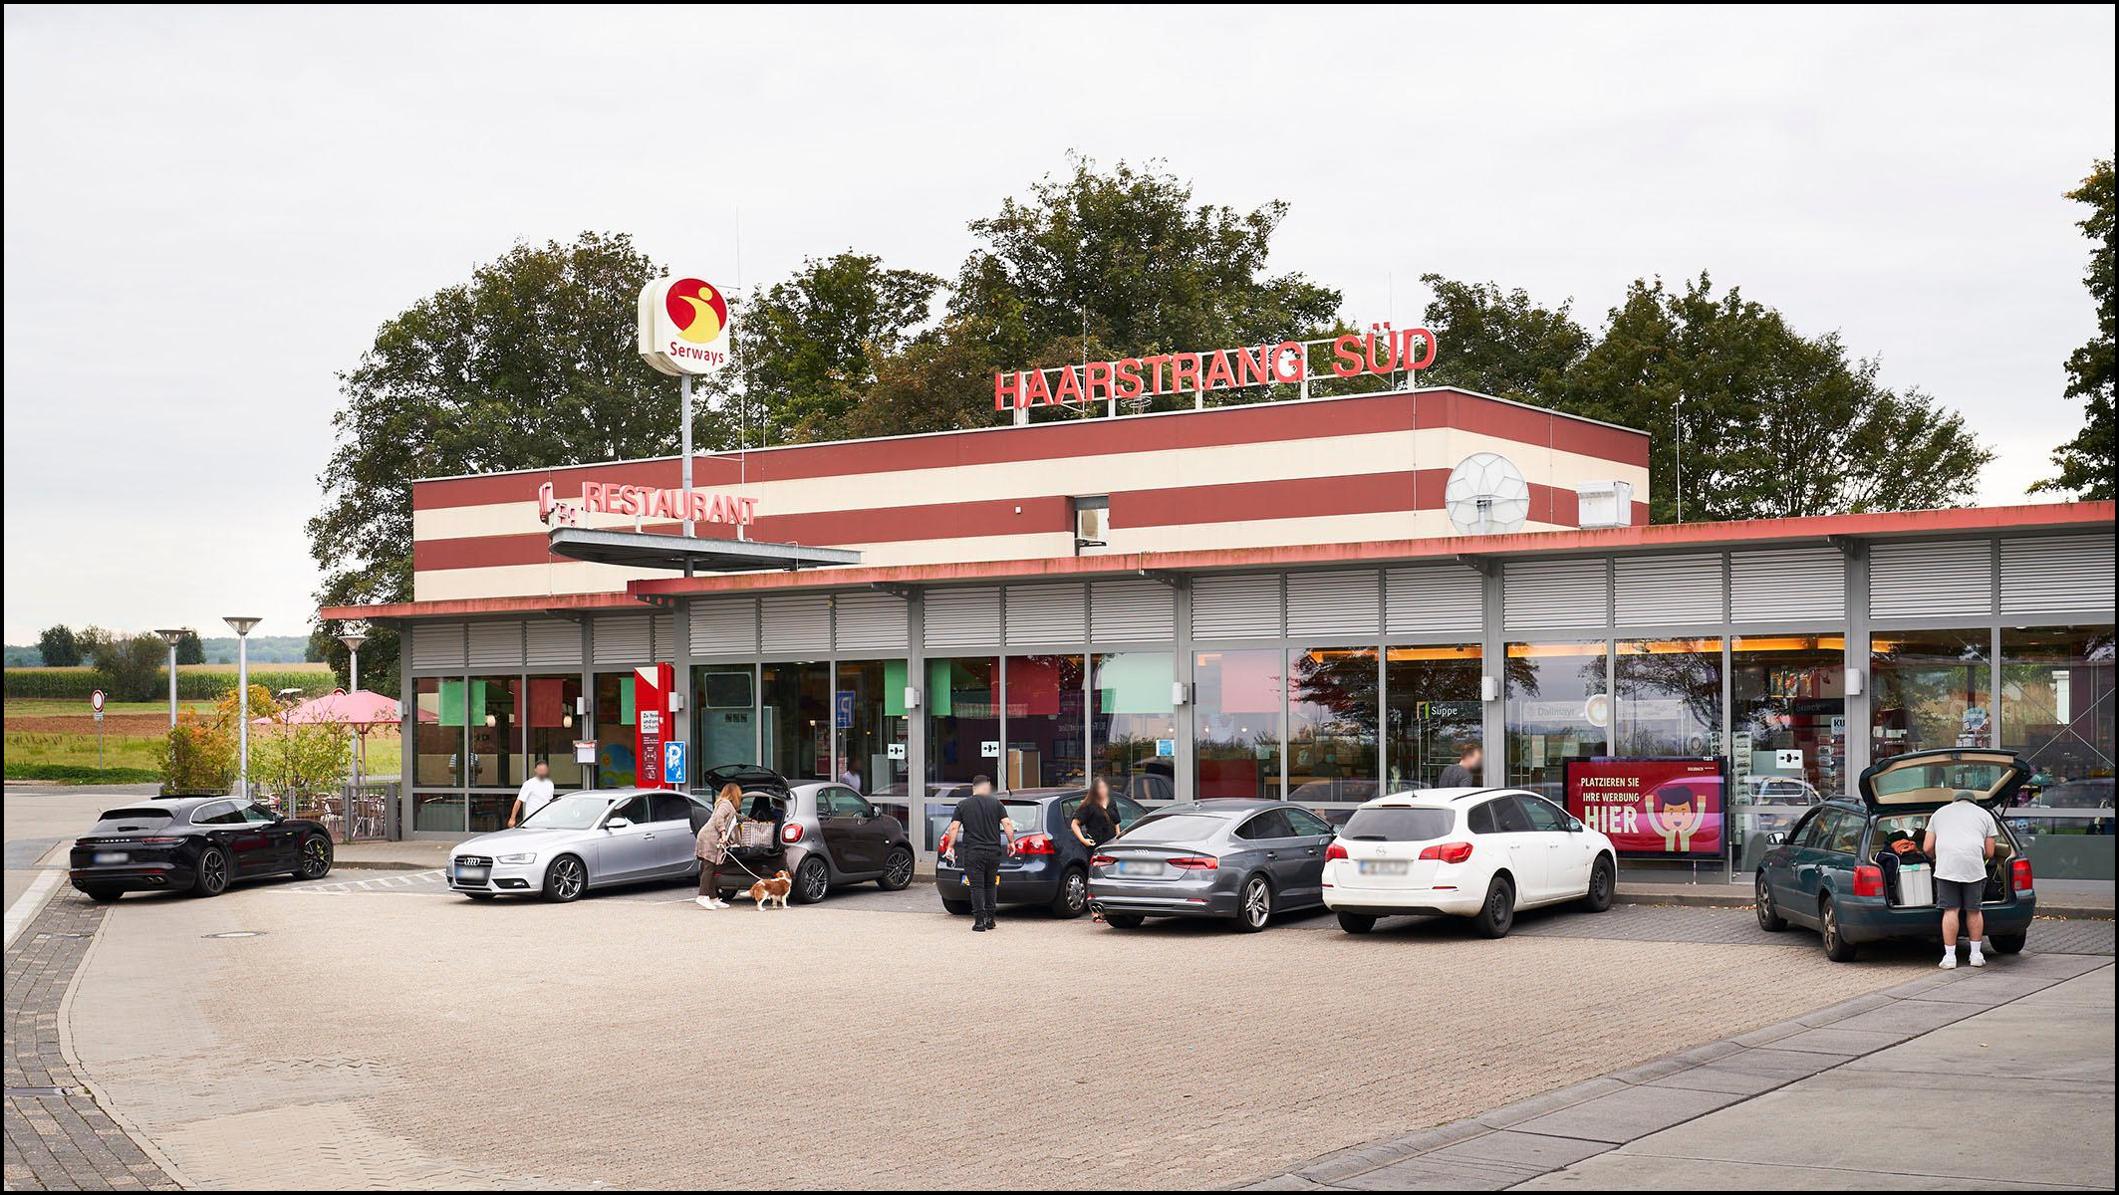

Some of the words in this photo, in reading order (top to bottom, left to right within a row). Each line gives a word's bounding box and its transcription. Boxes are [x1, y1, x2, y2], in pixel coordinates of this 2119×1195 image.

[670, 341, 724, 366] Serways
[994, 341, 1304, 411] HAARSTRANG
[1332, 321, 1437, 378] SÜD
[582, 481, 759, 525] RESTAURANT
[1431, 706, 1458, 717] Suppe
[1581, 777, 1626, 787] PLATZIEREN
[1627, 777, 1640, 787] SIE
[1583, 792, 1600, 802] IHRE
[1601, 792, 1640, 802] WERBUNG
[1584, 805, 1640, 834] HIER
